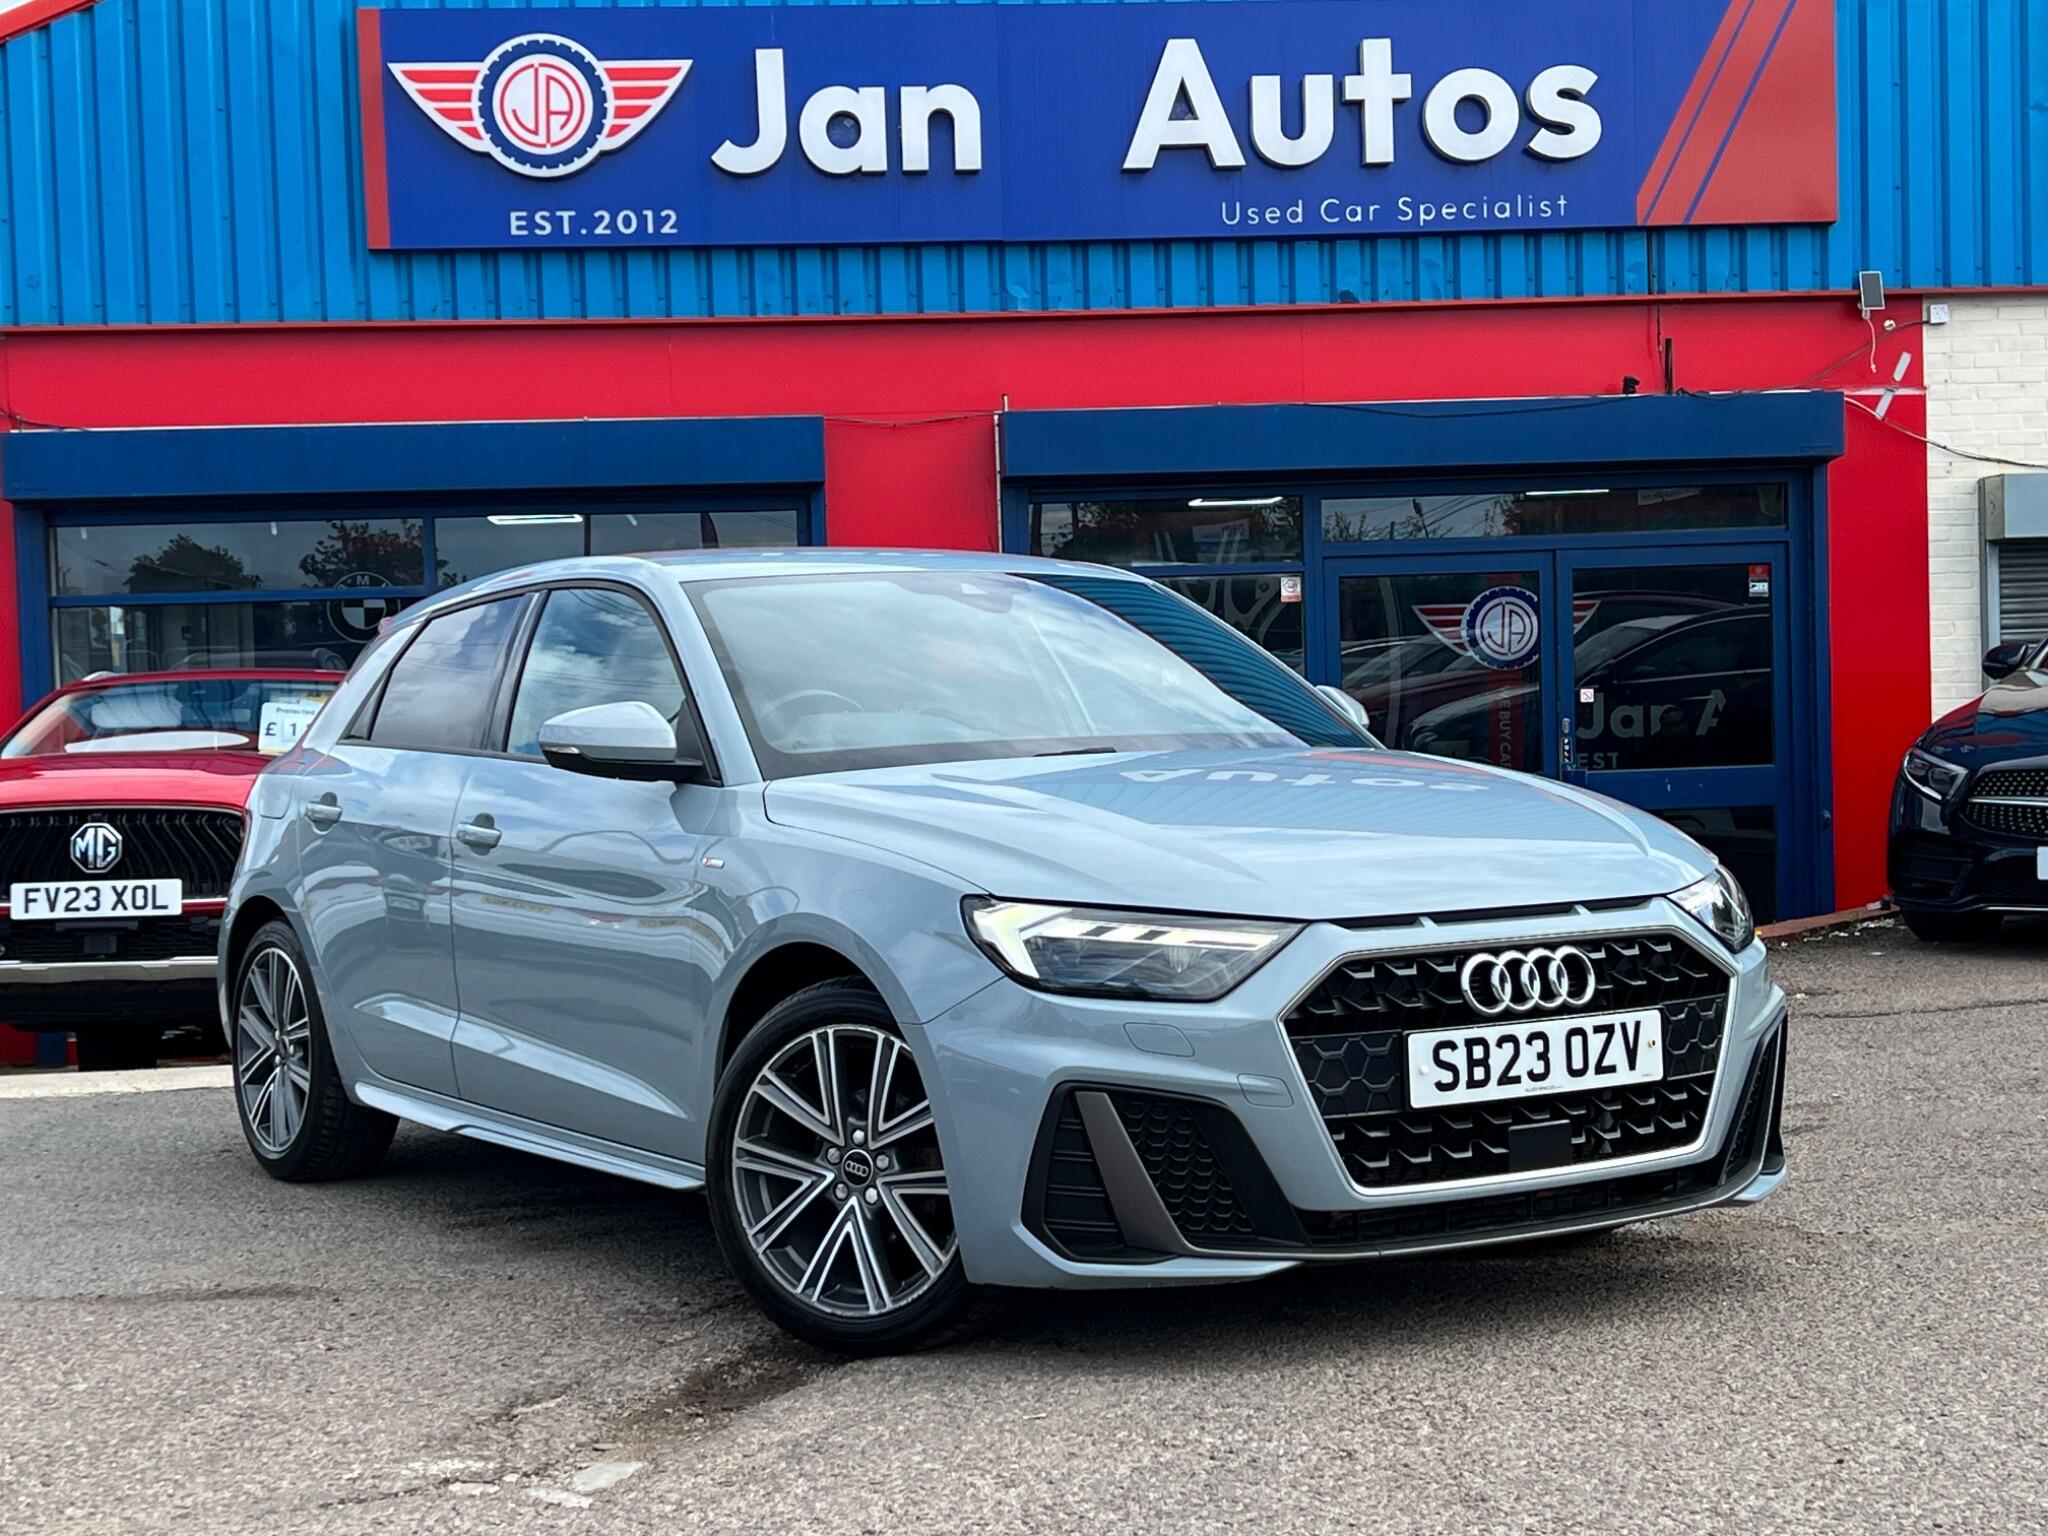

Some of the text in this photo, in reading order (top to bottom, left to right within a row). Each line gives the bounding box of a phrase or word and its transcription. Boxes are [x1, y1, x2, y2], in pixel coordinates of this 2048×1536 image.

[711, 36, 1602, 175] Jan Autos
[509, 208, 679, 236] EST.2012
[1221, 193, 1568, 226] Used Car Specialist
[75, 827, 117, 868] MG
[24, 884, 169, 914] FV23 XOL
[1432, 1020, 1642, 1092] SB23 OZV
